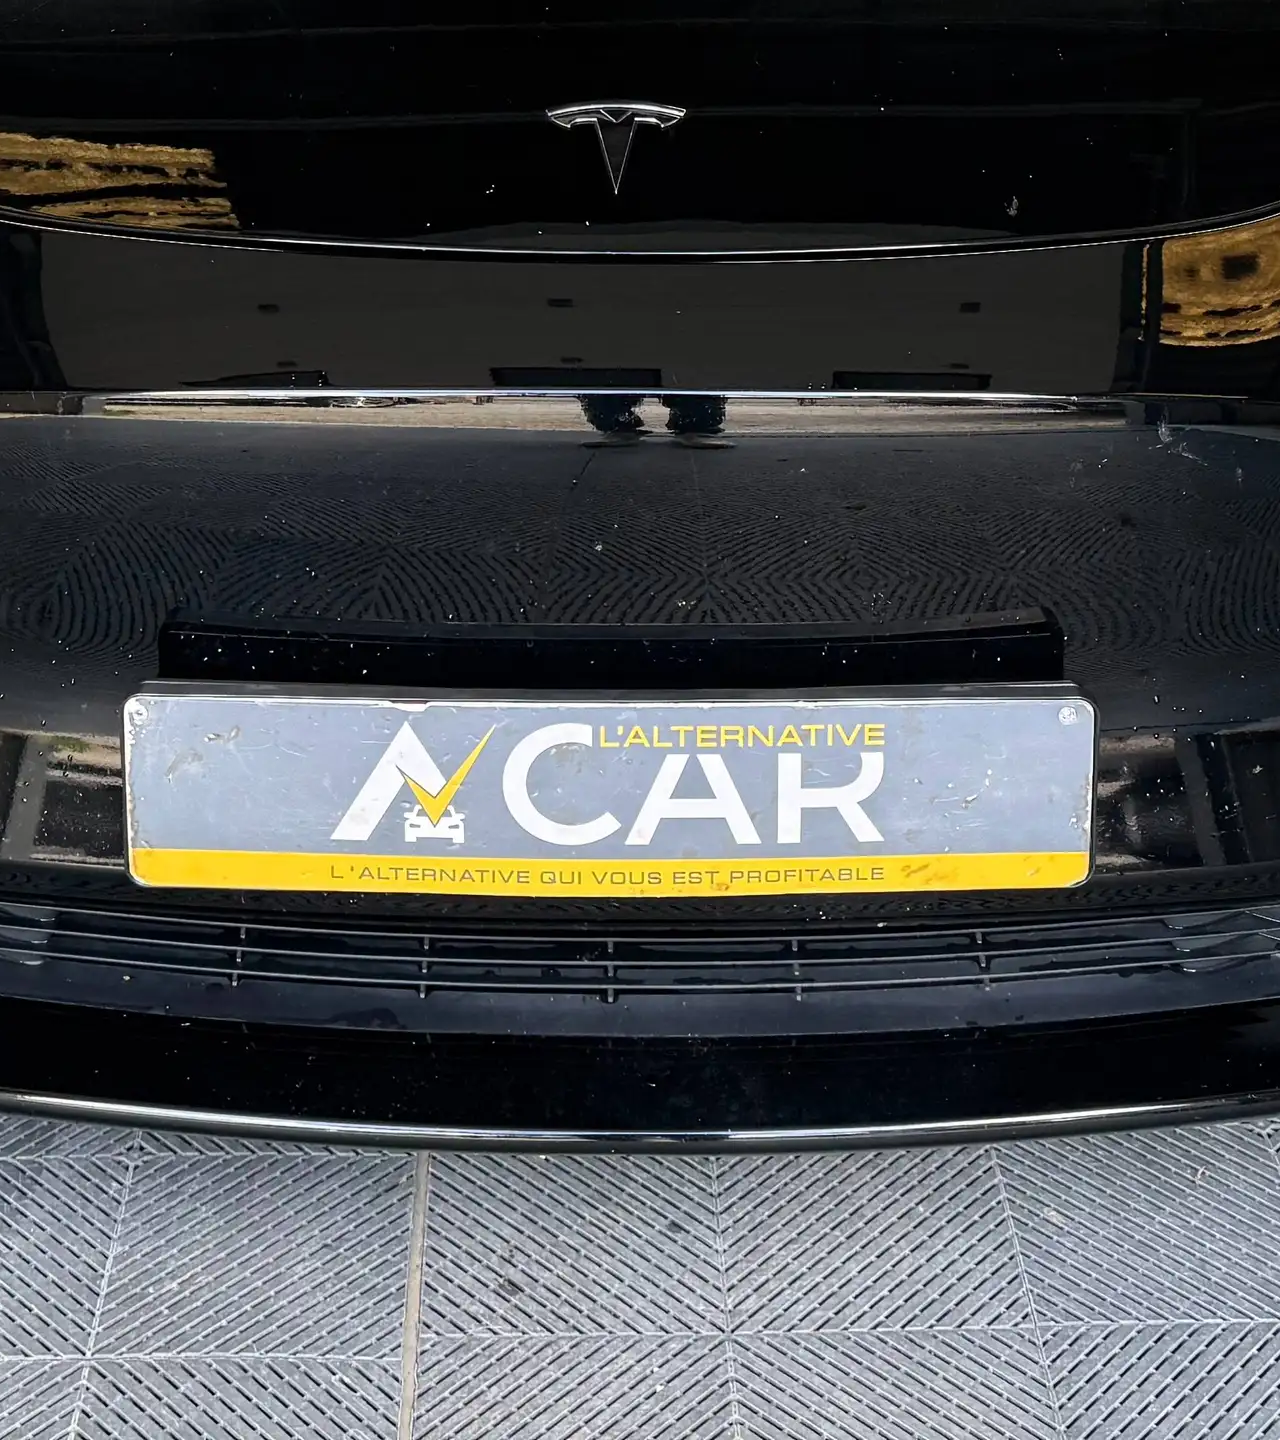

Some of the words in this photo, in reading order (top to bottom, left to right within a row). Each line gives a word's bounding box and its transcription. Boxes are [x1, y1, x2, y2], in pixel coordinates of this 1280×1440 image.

[600, 723, 886, 749] L'ALTERNATIVE
[502, 722, 886, 846] CAR
[331, 865, 530, 884] L'ALTERNATIVE
[540, 871, 582, 885] QUI
[592, 871, 662, 885] VOUS
[673, 871, 719, 885] EST
[730, 867, 885, 883] PROFITABLE
